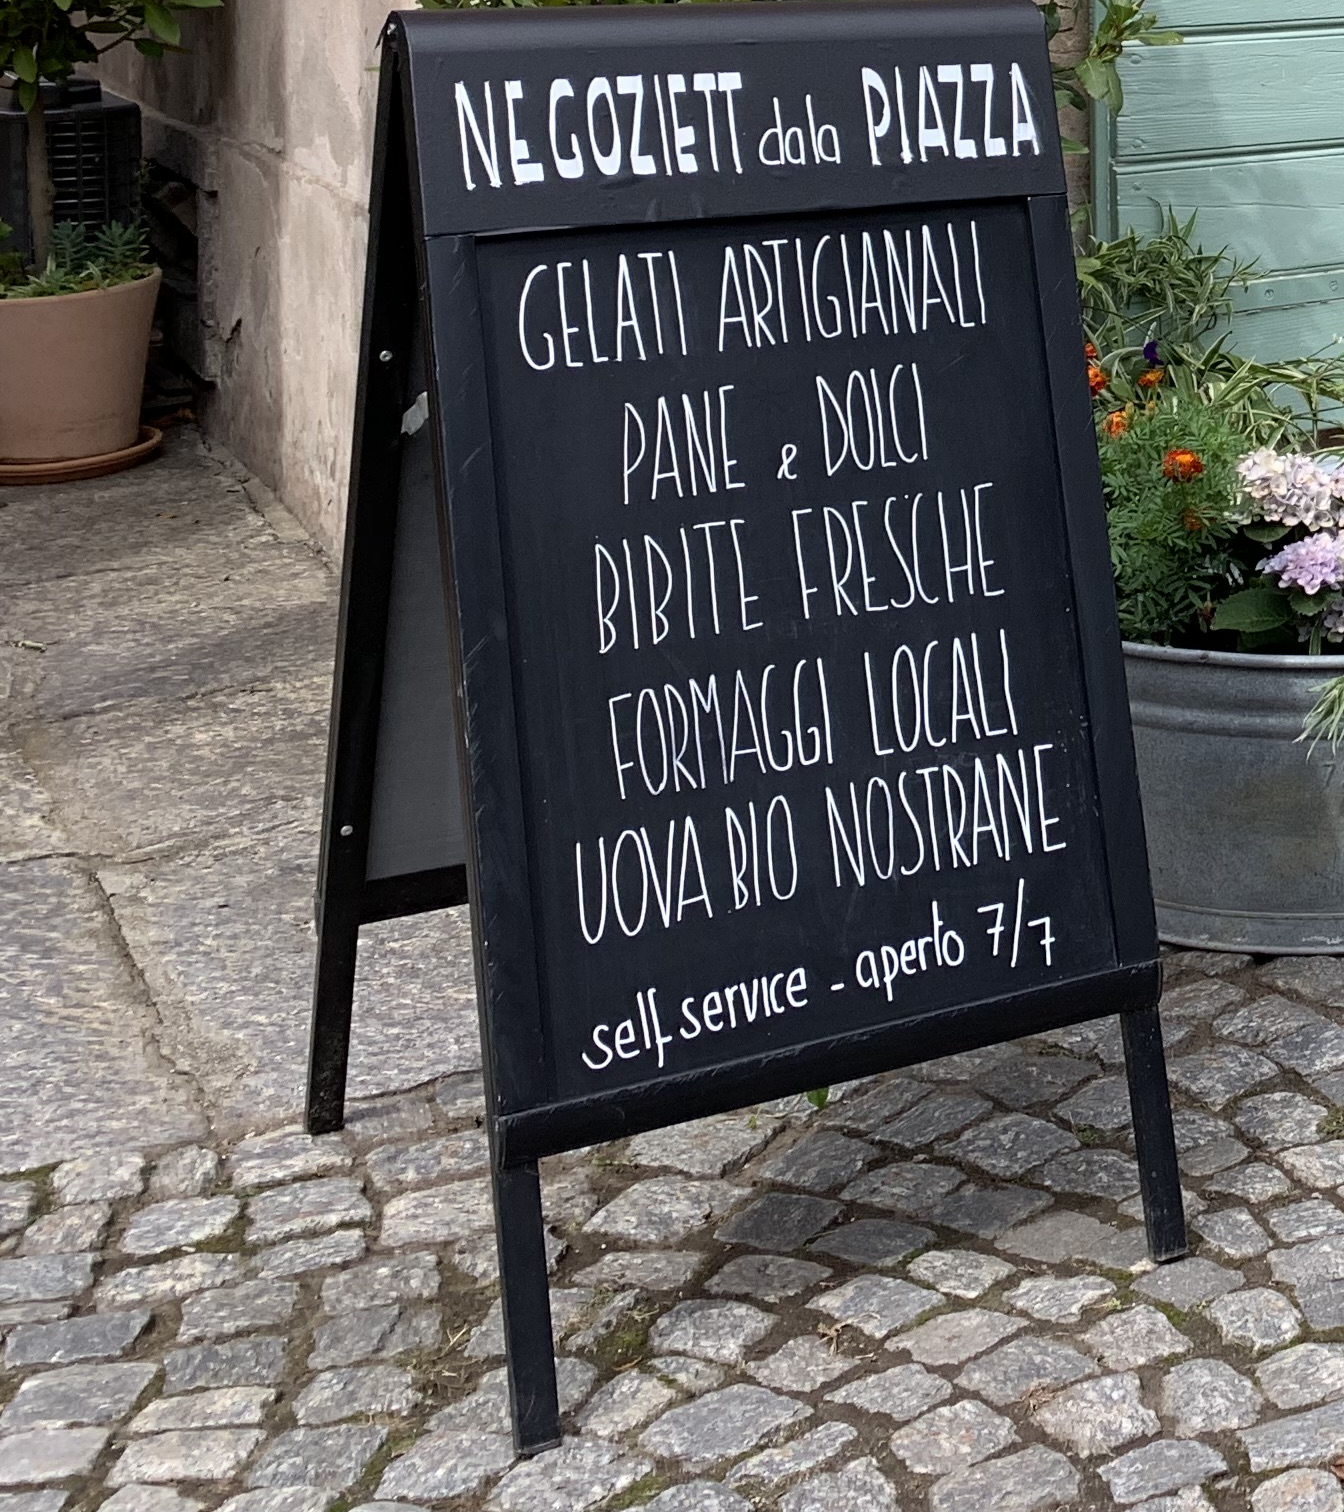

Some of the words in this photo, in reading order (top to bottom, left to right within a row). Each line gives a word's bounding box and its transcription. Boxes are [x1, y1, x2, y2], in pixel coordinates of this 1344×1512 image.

[455, 72, 742, 190] NEGOZIETT
[759, 94, 840, 165] dala
[862, 63, 1039, 165] PIAZZA
[519, 251, 687, 370] GELATI
[719, 221, 986, 351] ARTIGIANALI
[624, 385, 745, 504] PANE
[816, 363, 928, 476] DOLCI
[595, 520, 763, 653] BIBITE
[792, 483, 1004, 619] FRESCHE
[609, 658, 833, 799] FORMAGGI
[864, 629, 1017, 755] LOCALI
[576, 816, 712, 944] UOVA
[725, 795, 797, 909] BIO
[826, 744, 1067, 887] NOSTRANE
[582, 988, 672, 1069] self
[680, 968, 807, 1039] service
[856, 901, 964, 1001] aperto
[977, 878, 1055, 967] 7/7
